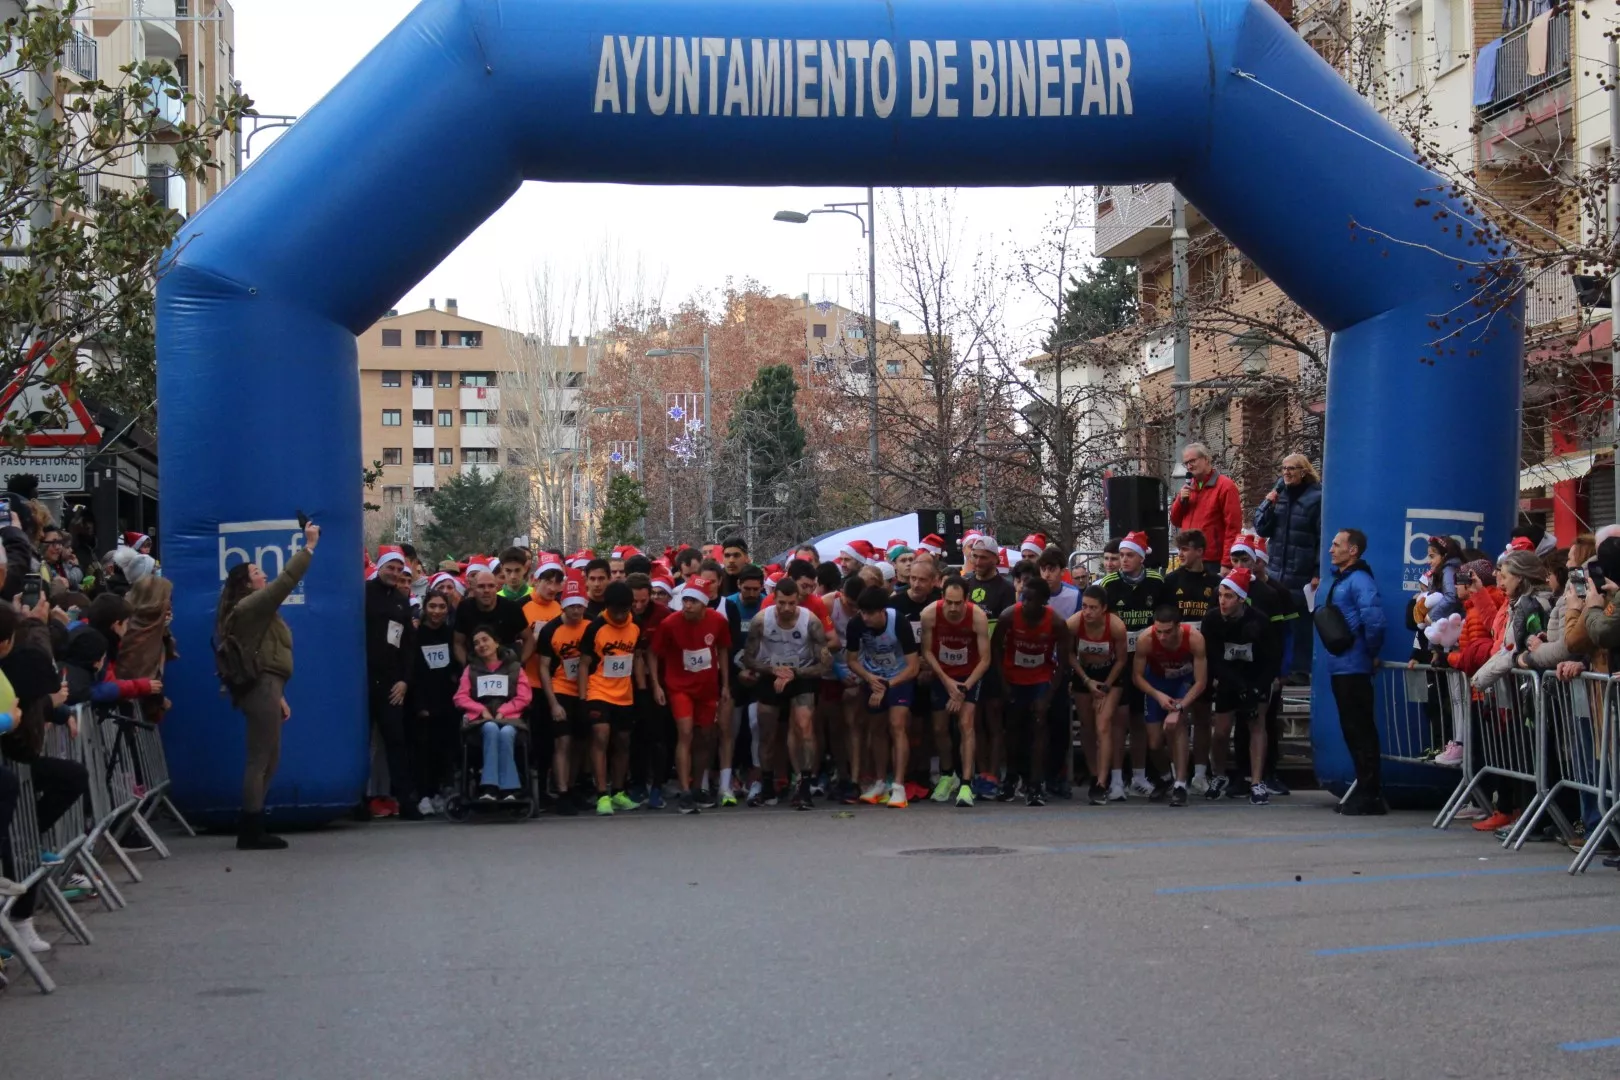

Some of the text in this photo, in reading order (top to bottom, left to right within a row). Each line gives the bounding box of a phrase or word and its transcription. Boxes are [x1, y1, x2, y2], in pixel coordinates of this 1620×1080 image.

[594, 35, 1133, 118] AYUNTAMIENTO DE BINEFAR
[1, 457, 26, 466] PASO
[427, 651, 445, 661] 176
[690, 656, 703, 666] 34
[612, 661, 625, 671] 84
[483, 680, 502, 690] 178
